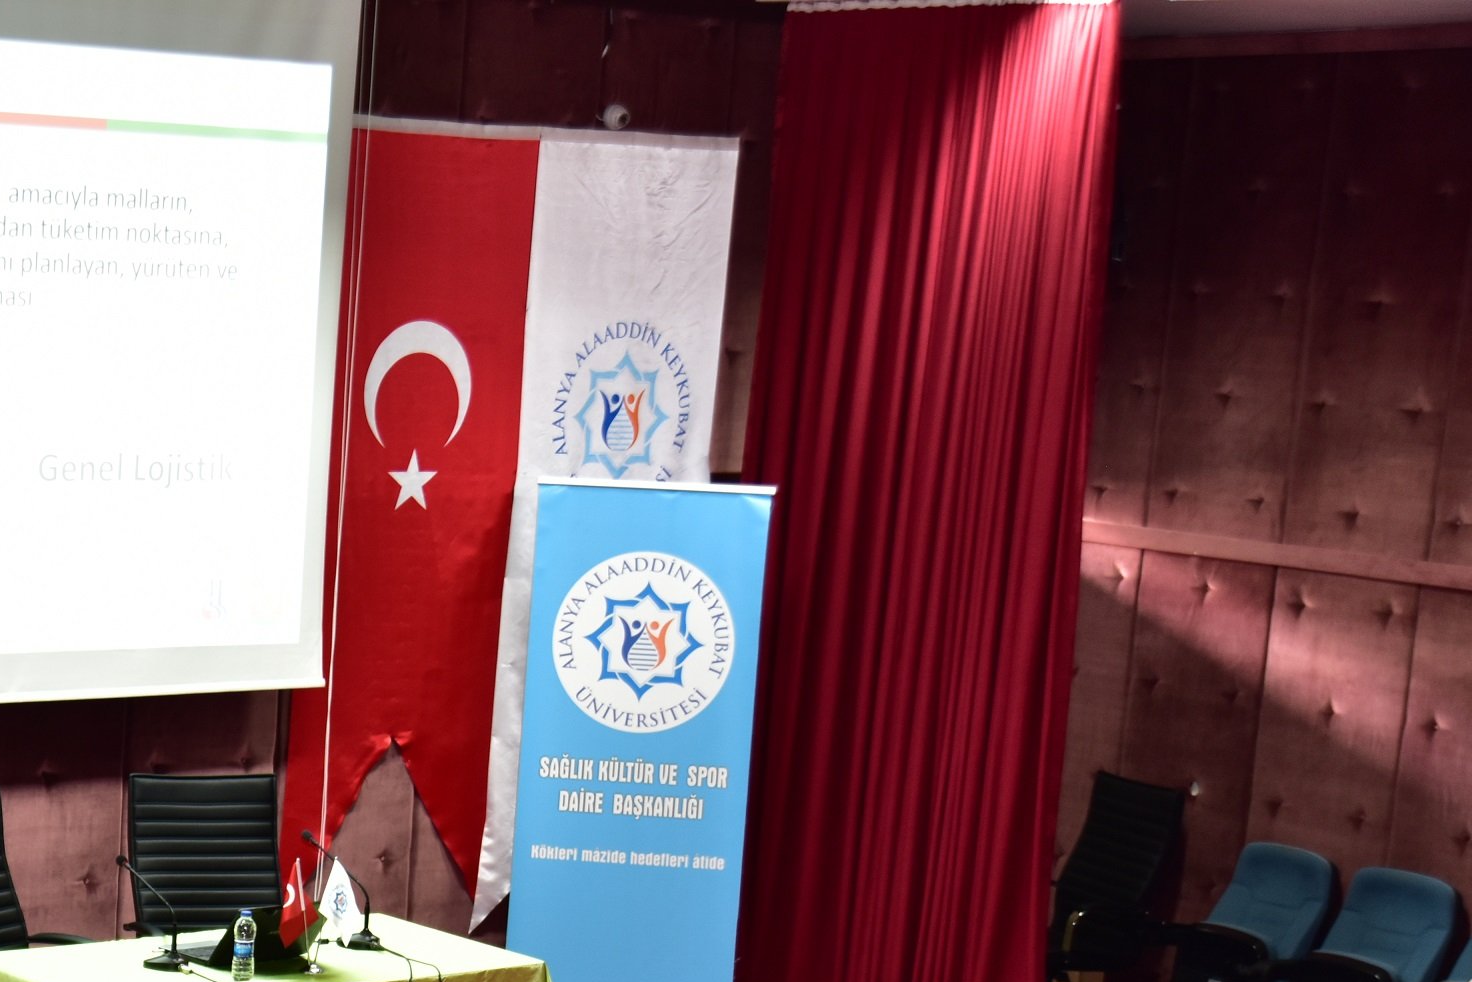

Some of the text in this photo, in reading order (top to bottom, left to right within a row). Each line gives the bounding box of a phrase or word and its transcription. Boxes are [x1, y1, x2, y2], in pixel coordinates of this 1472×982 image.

[8, 184, 99, 215] amacıyla
[106, 188, 193, 215] malların,
[41, 217, 119, 242] tüketim
[127, 222, 229, 249] noktasına,
[21, 251, 125, 279] planlayan,
[217, 263, 239, 281] ve
[552, 322, 690, 455] ALANYA ALAADDİN KEYKUBAT
[39, 452, 233, 489] Genel Lojistik
[559, 557, 729, 679] ALANYA ALAADDİN KEYKUBAT
[575, 686, 708, 728] ÜNİVERSİTESİ
[539, 754, 728, 788] SAĞLIK KÜLTÜR VE SPOR
[558, 788, 704, 820] DAİRE BAŞKANLIĞI
